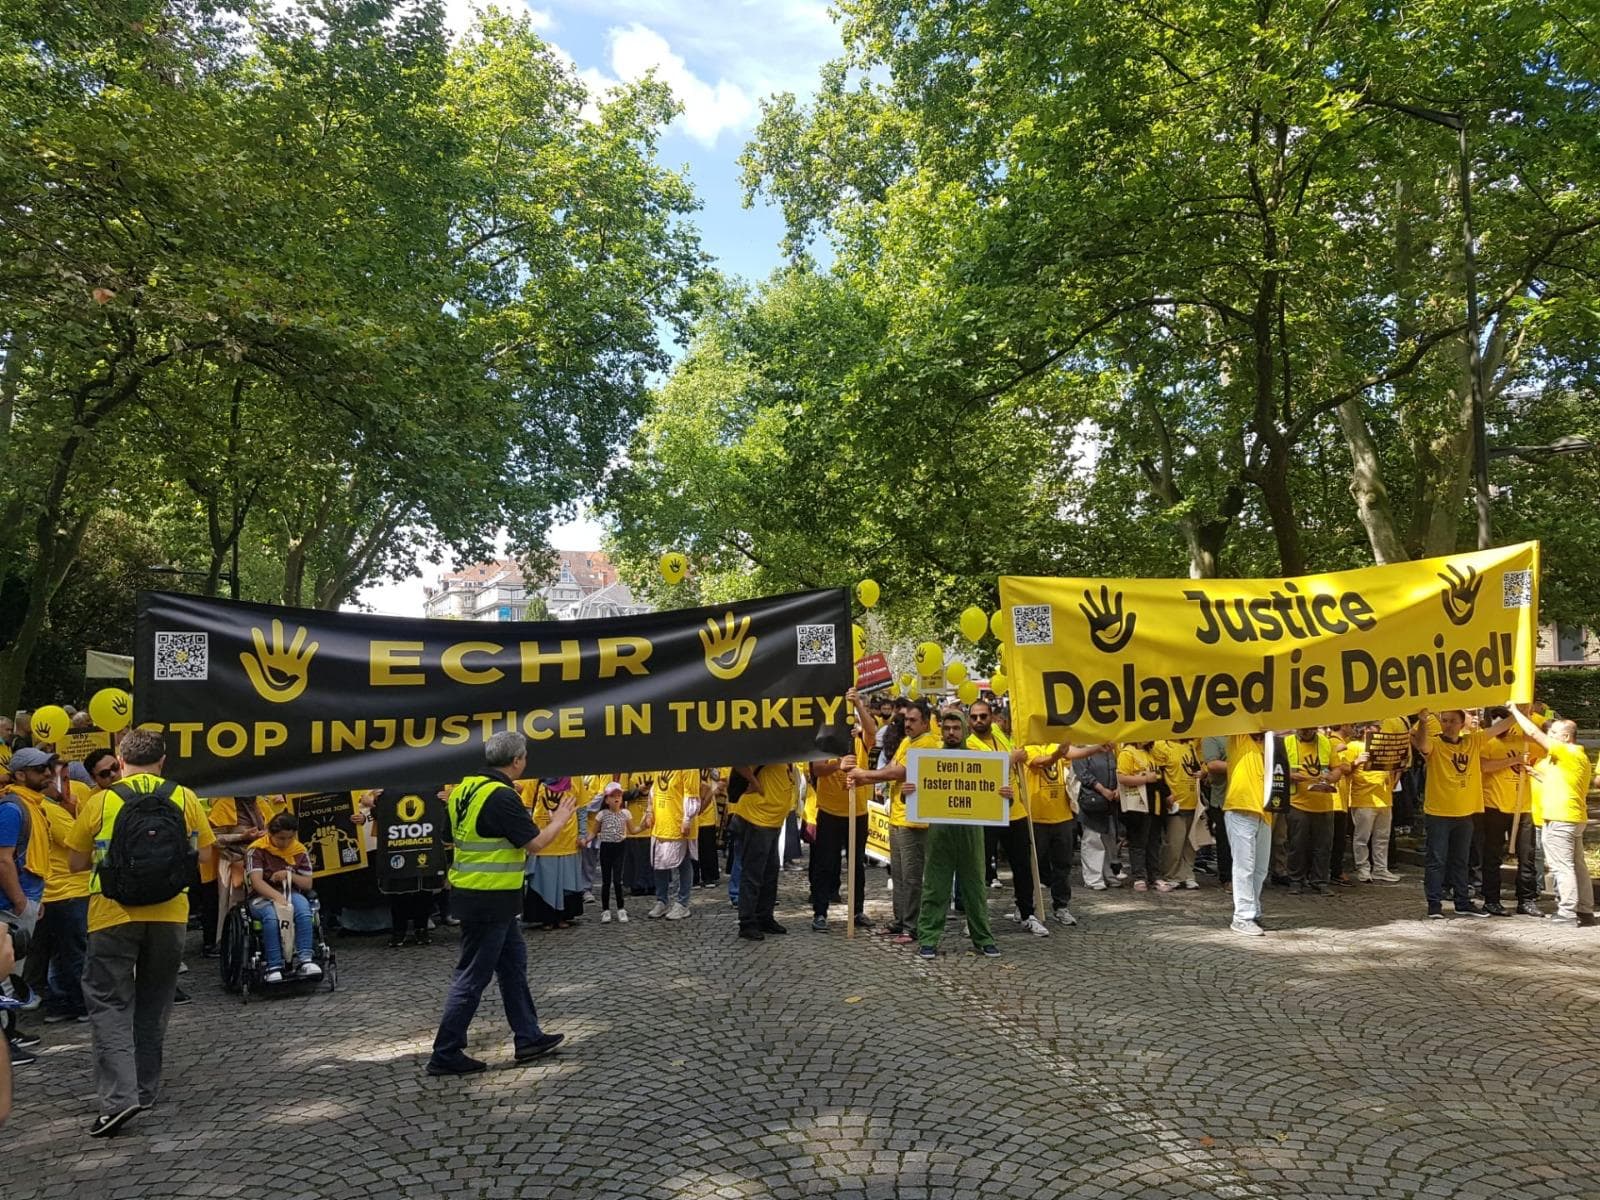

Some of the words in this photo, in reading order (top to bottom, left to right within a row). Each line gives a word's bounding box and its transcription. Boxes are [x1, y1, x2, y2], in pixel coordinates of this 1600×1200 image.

[1182, 582, 1378, 646] Justice
[369, 636, 654, 686] ECHR
[1041, 654, 1278, 733] Delayed
[1290, 648, 1329, 709] is
[1342, 631, 1516, 704] Denied!
[311, 706, 587, 754] INJUSTICE
[604, 703, 652, 736] IN
[668, 695, 855, 732] TURKEY!
[936, 760, 959, 773] Even
[961, 761, 964, 773] I
[966, 762, 982, 774] am
[923, 777, 953, 790] faster
[954, 778, 977, 791] than
[979, 779, 996, 792] the
[948, 796, 972, 809] ECHR
[311, 807, 332, 816] YOUR
[388, 823, 434, 840] STOP
[387, 837, 433, 848] PUSHBACKS
